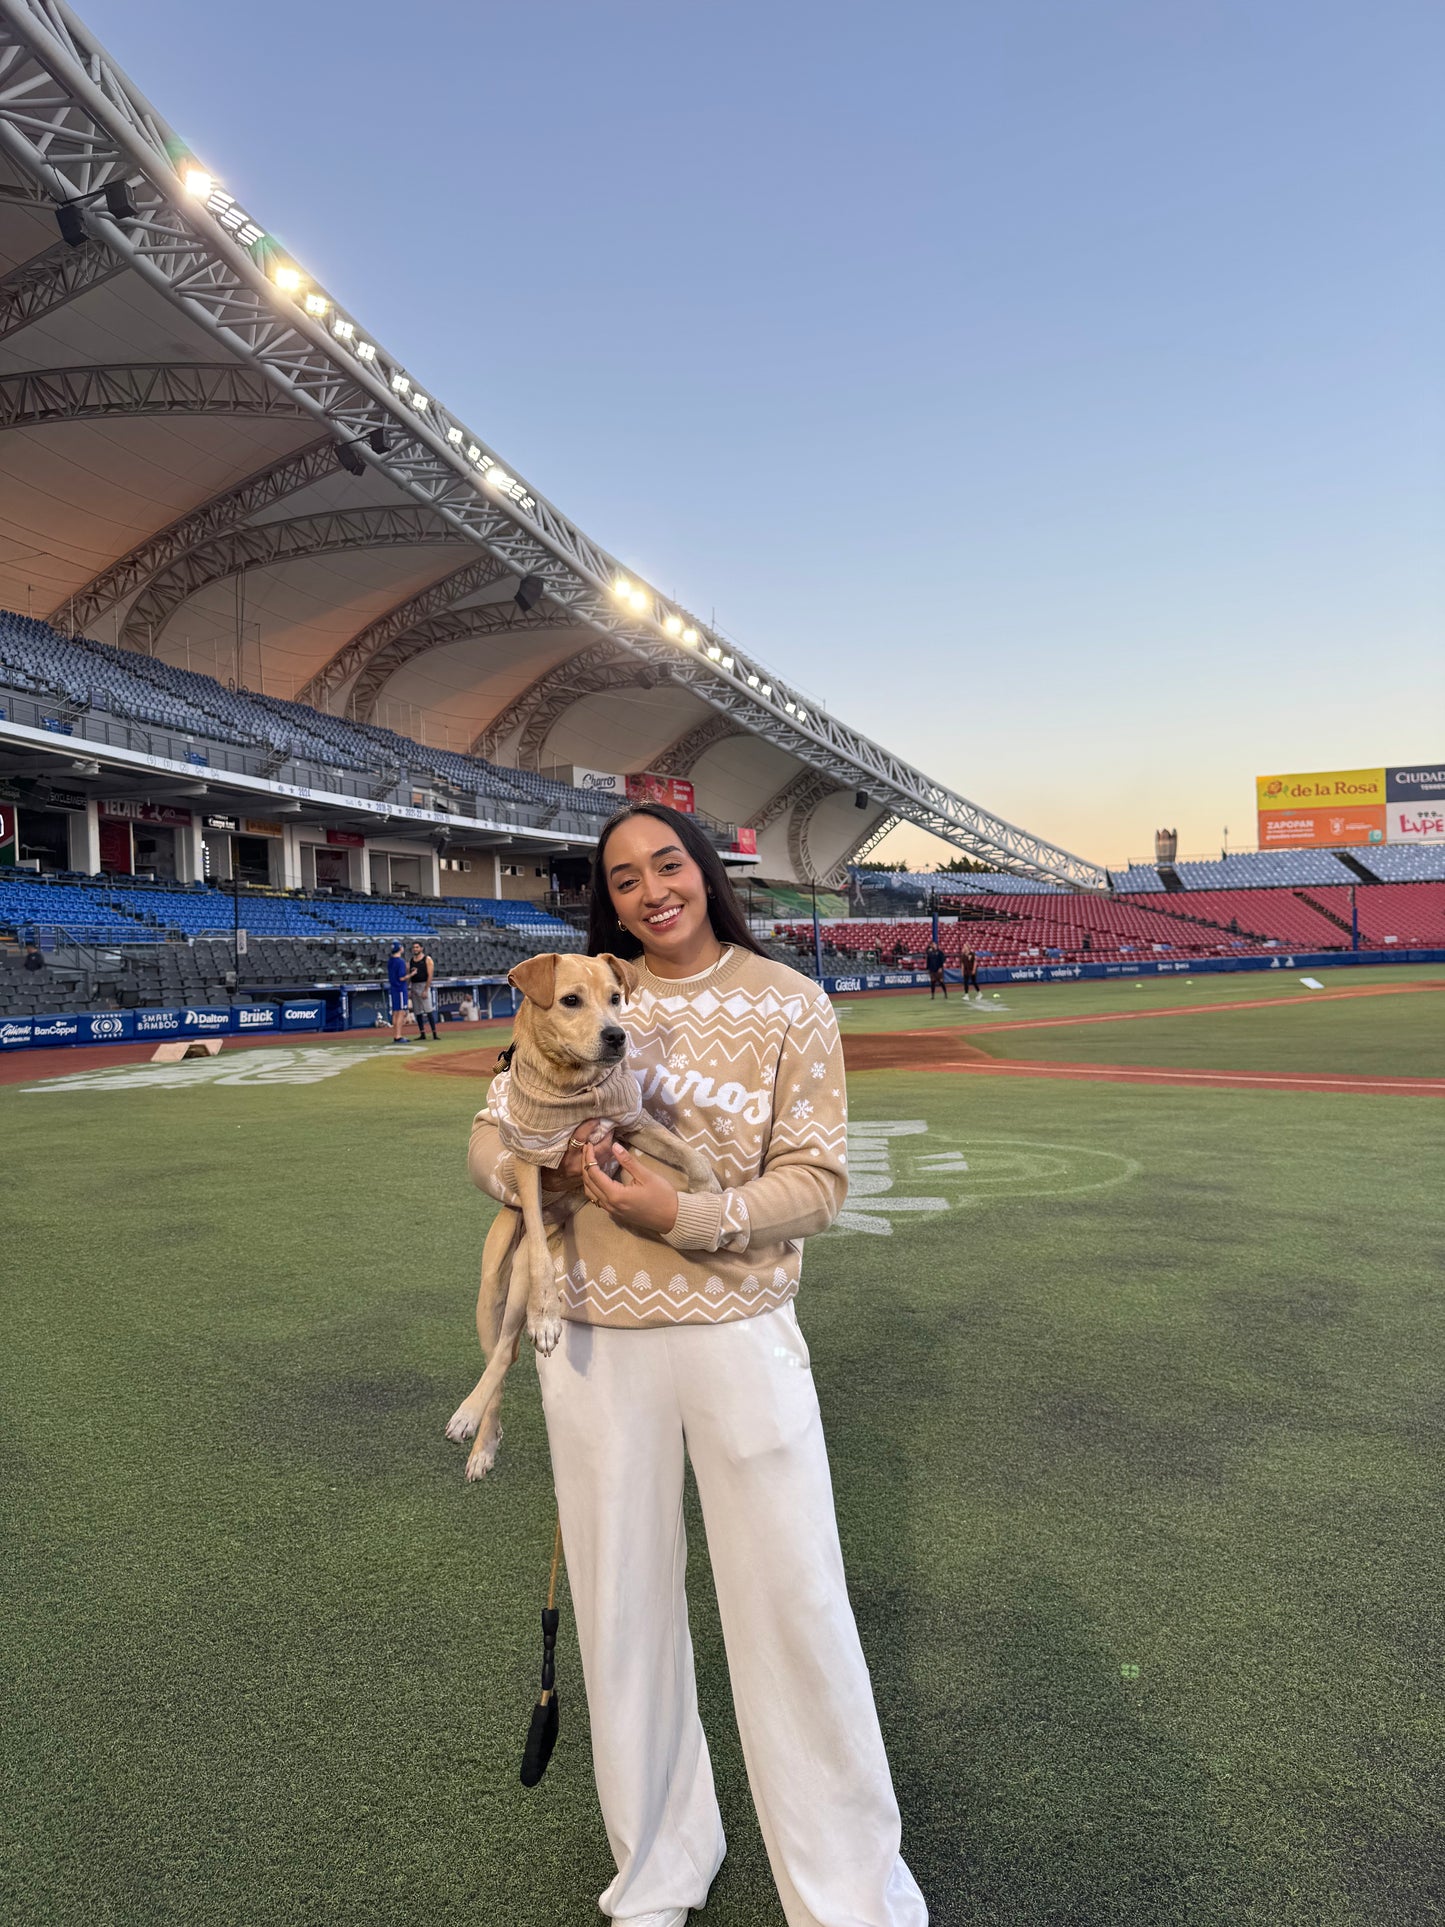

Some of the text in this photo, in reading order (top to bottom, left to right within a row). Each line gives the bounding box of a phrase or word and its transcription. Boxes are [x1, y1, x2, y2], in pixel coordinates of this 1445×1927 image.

[582, 773, 616, 790] Charros
[1395, 771, 1445, 784] CIUDAD
[1290, 781, 1378, 797] de la Rosa
[103, 799, 144, 819] TECATE
[1267, 819, 1314, 830] ZAPOPAN
[1011, 968, 1035, 979] volaris
[1050, 966, 1073, 977] volaris
[142, 1013, 173, 1022] SMART
[198, 1014, 229, 1023] Dalton
[239, 1008, 274, 1023] Brück
[285, 1009, 318, 1020] Comex
[34, 1025, 77, 1036] BanCoppel
[137, 1020, 178, 1031] BAMBOO
